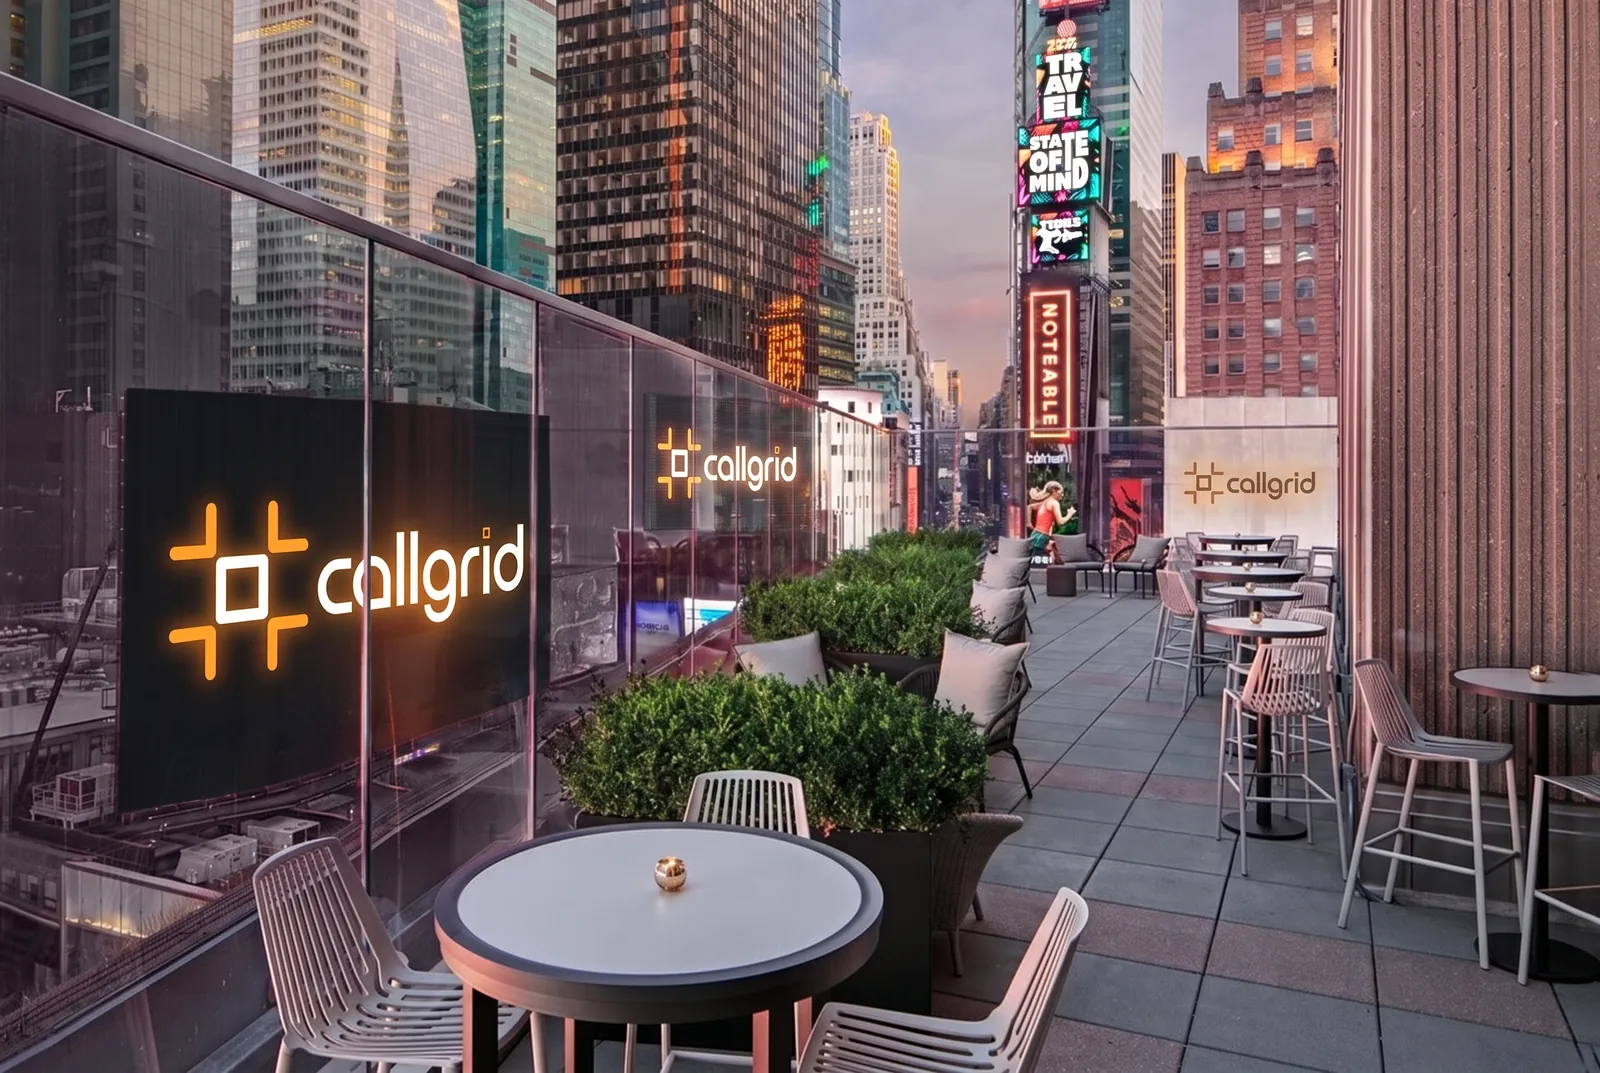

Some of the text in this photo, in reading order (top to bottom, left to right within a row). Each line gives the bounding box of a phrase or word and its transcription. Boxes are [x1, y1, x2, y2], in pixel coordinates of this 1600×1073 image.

[1029, 130, 1089, 171] STATE
[1029, 149, 1063, 173] OF
[1029, 157, 1089, 193] MIND
[1042, 303, 1058, 426] NOTEABLE
[703, 445, 797, 492] callgrid
[1226, 471, 1316, 500] callgrid
[317, 523, 524, 623] callgrid
